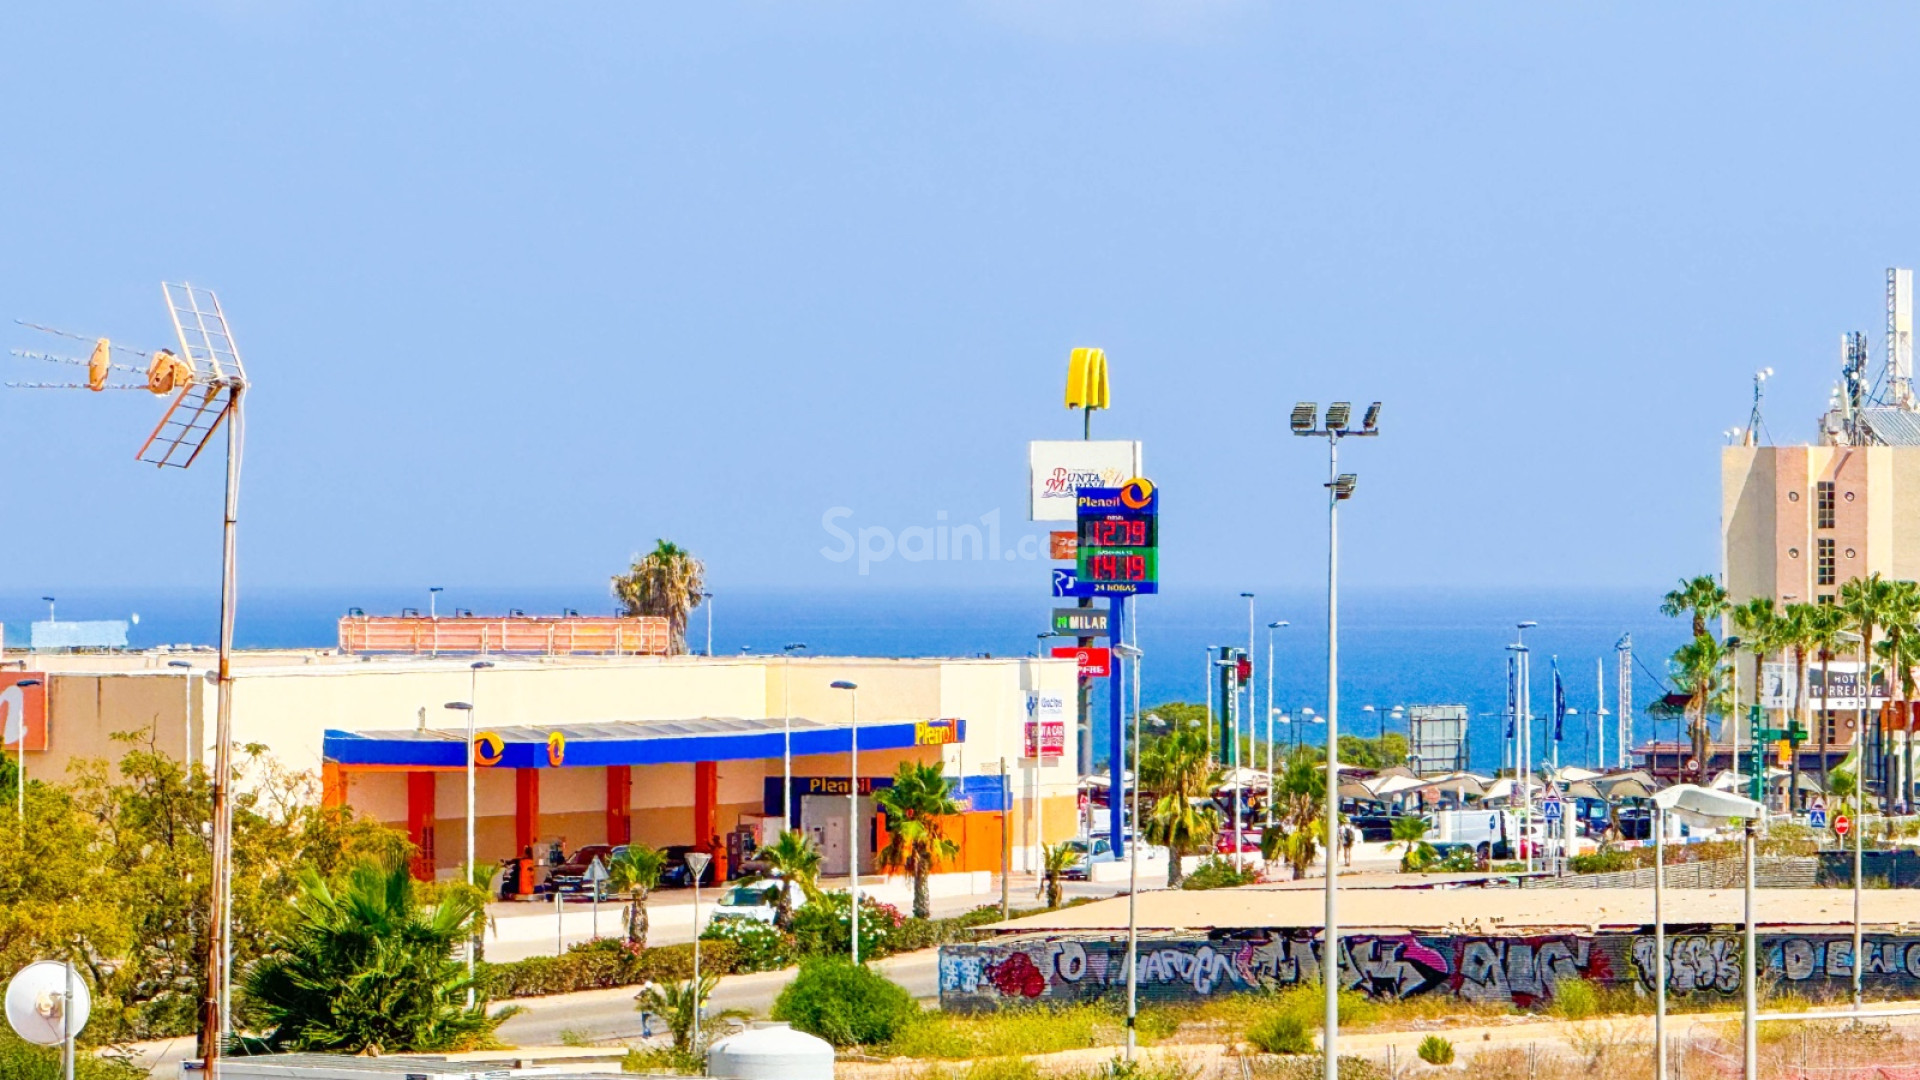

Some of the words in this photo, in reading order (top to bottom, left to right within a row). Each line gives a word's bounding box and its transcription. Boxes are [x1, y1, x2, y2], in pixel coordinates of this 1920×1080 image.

[1053, 468, 1101, 483] PUNTA
[1078, 497, 1120, 507] Plenoil
[1069, 616, 1107, 629] MILAR
[915, 719, 957, 744] Plenoil
[810, 778, 871, 792] Plenil
